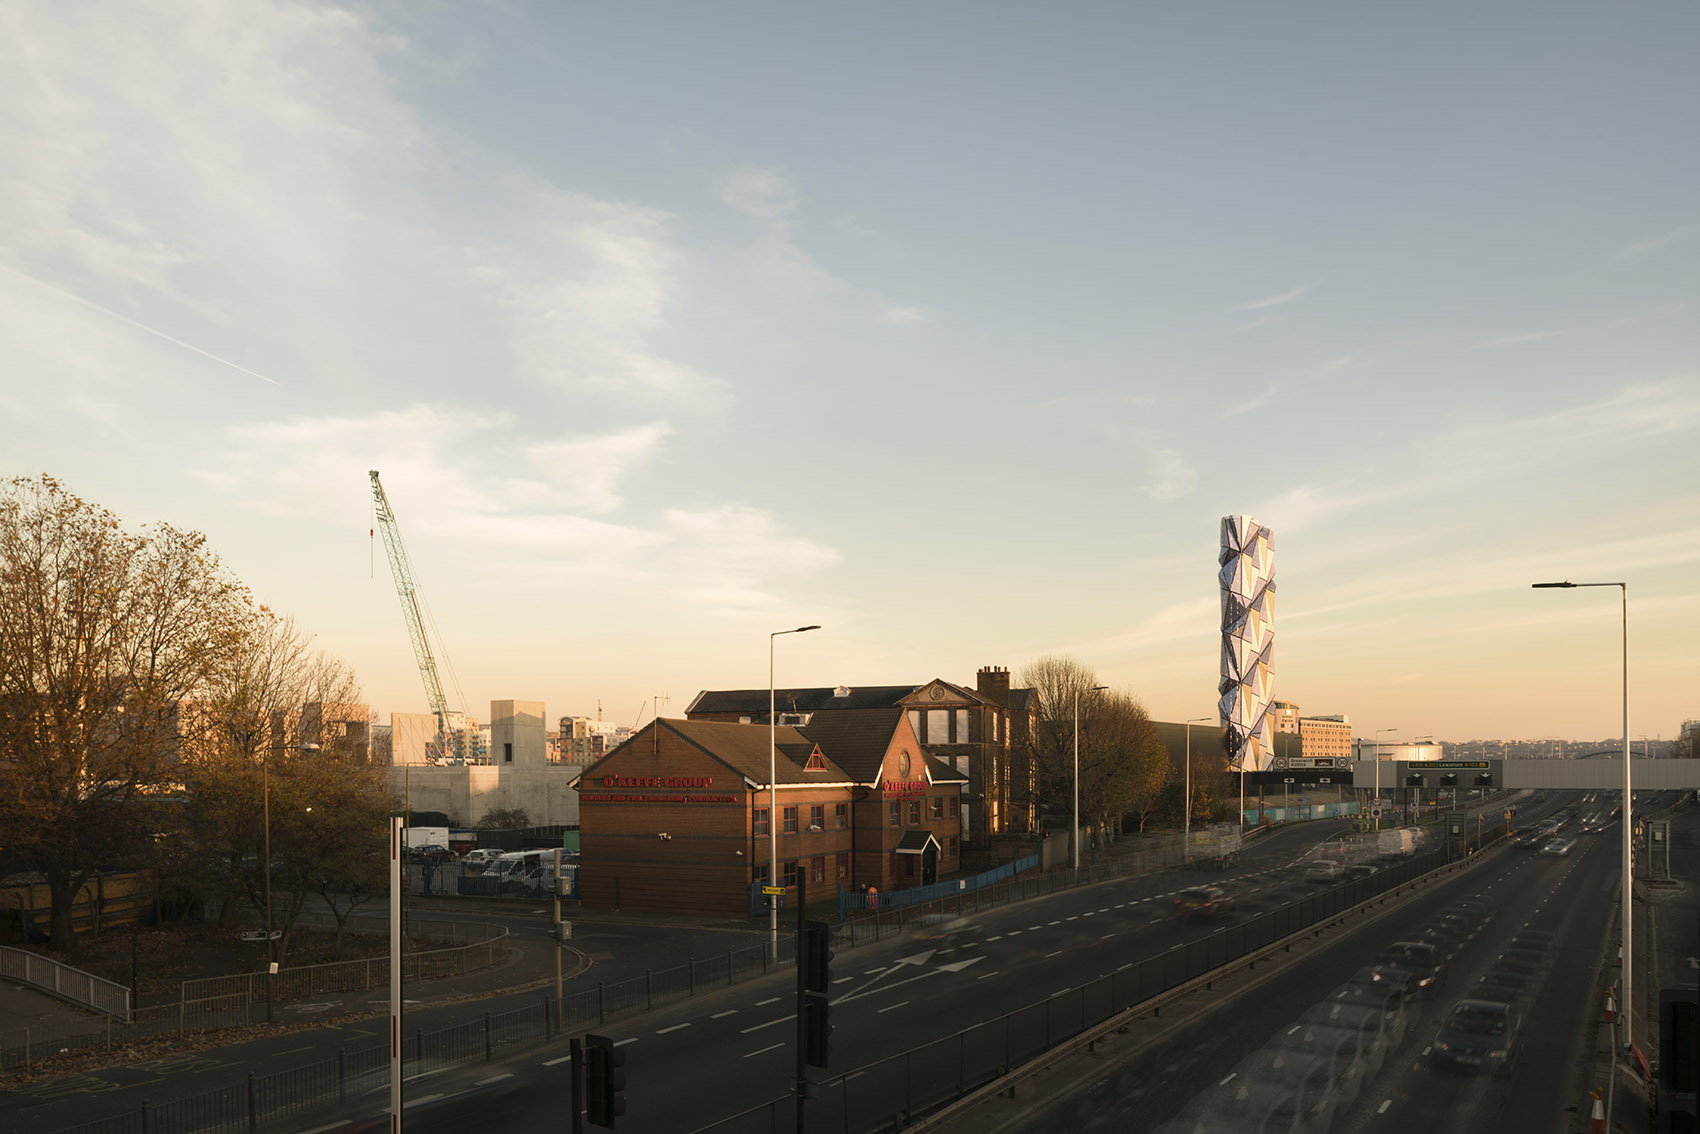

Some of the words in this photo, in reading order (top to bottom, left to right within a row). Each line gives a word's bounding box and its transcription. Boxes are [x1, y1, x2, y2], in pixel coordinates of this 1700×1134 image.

[603, 774, 660, 788] O'KEEFE
[664, 776, 713, 788] GROUP
[883, 780, 907, 791] O'KEEFE
